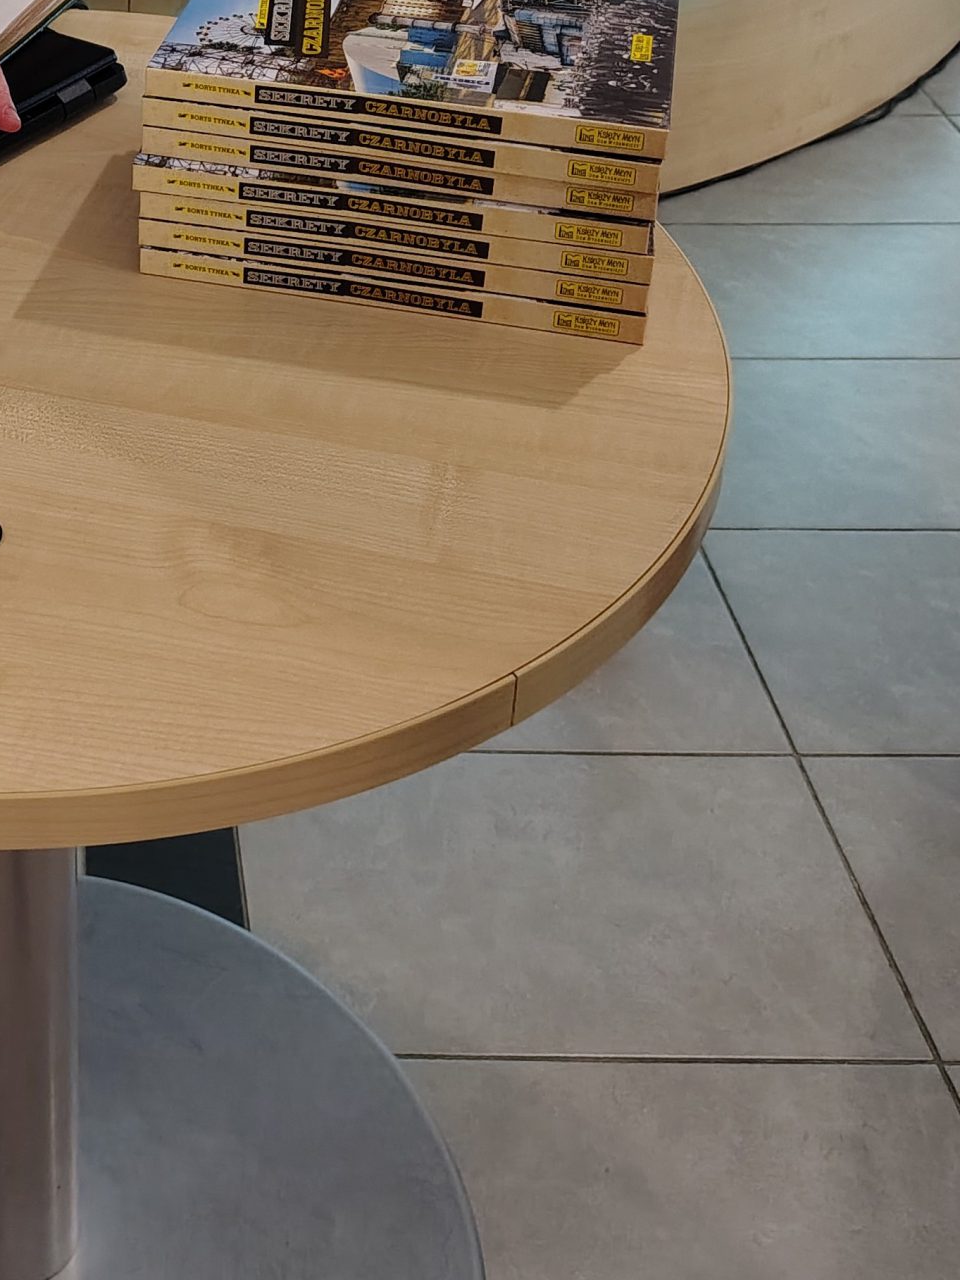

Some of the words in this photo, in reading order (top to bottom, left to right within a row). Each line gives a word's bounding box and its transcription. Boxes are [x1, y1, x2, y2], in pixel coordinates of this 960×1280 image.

[195, 83, 217, 92] BORYS
[218, 86, 240, 95] TYNKA
[258, 89, 356, 110] SEKRETY
[365, 100, 491, 130] CZARNOBYLA
[190, 114, 212, 123] BORYS
[214, 116, 235, 126] TYNKA
[253, 121, 350, 142] SEKRETY
[359, 133, 484, 163] CZARNOBYLA
[191, 142, 212, 151] BORYS
[214, 144, 235, 154] TYNKA
[253, 150, 350, 170] SEKRETY
[359, 162, 483, 191] CZARNOBYLA
[179, 180, 200, 189] BORYS
[202, 182, 224, 192] TYNKA
[242, 187, 340, 207] SEKRETY
[348, 198, 472, 227] CZARNOBYLA
[187, 207, 208, 217] BORYS
[210, 210, 232, 220] TYNKA
[250, 213, 346, 235] SEKRETY
[354, 226, 477, 255] CZARNOBYLA
[185, 234, 206, 244] BORYS
[208, 237, 230, 247] TYNKA
[247, 242, 344, 263] SEKRETY
[351, 254, 474, 283] CZARNOBYLA
[185, 264, 206, 274] BORYS
[207, 266, 229, 277] TYNKA
[247, 271, 341, 292] SEKRETY
[350, 284, 472, 313] CZARNOBYLA
